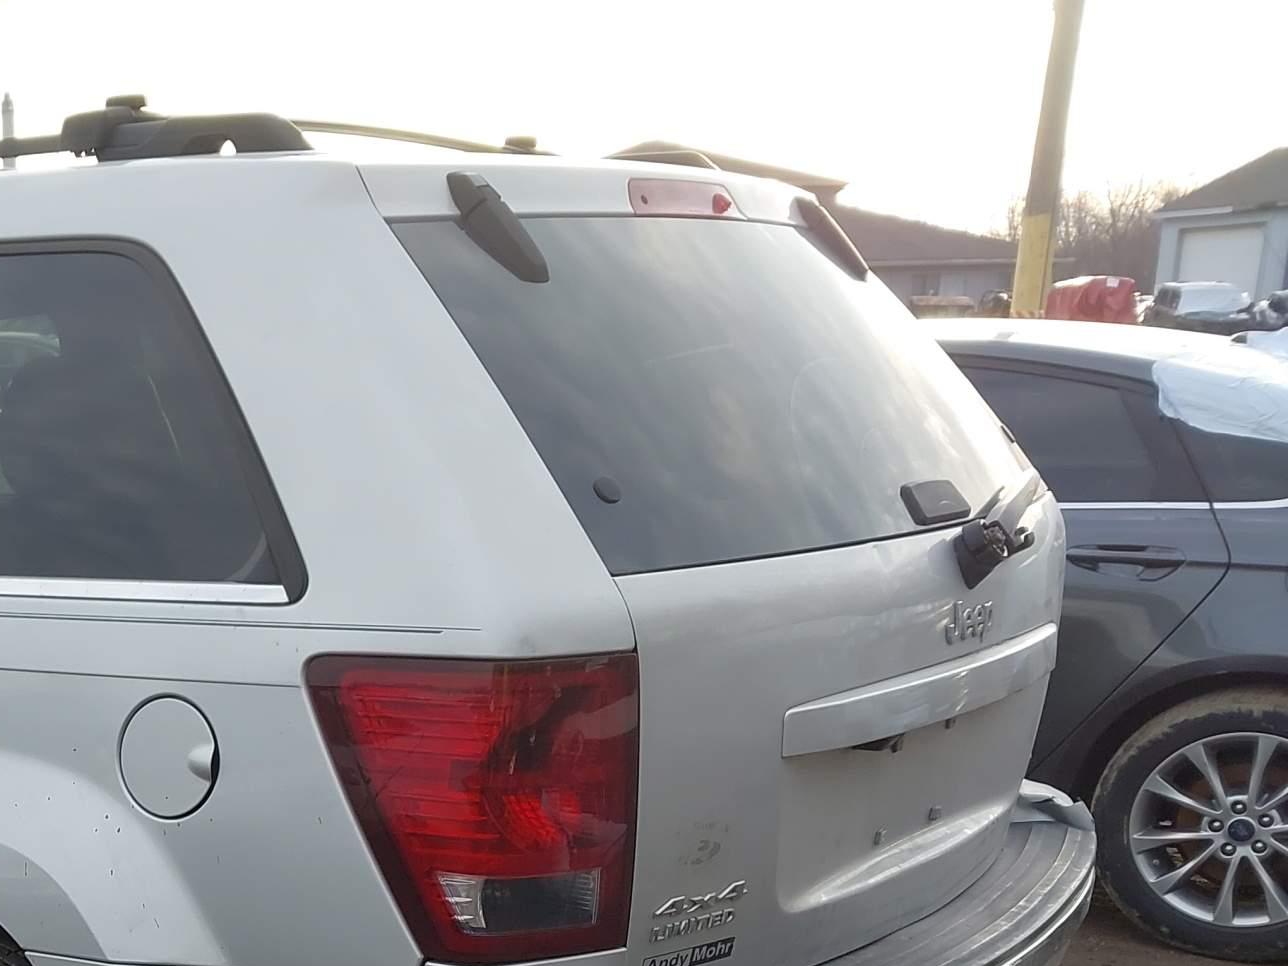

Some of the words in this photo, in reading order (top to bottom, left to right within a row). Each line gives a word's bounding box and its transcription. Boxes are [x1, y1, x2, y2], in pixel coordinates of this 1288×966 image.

[945, 600, 993, 646] Jeep
[649, 908, 736, 944] LIMITED
[692, 941, 733, 962] Mohr
